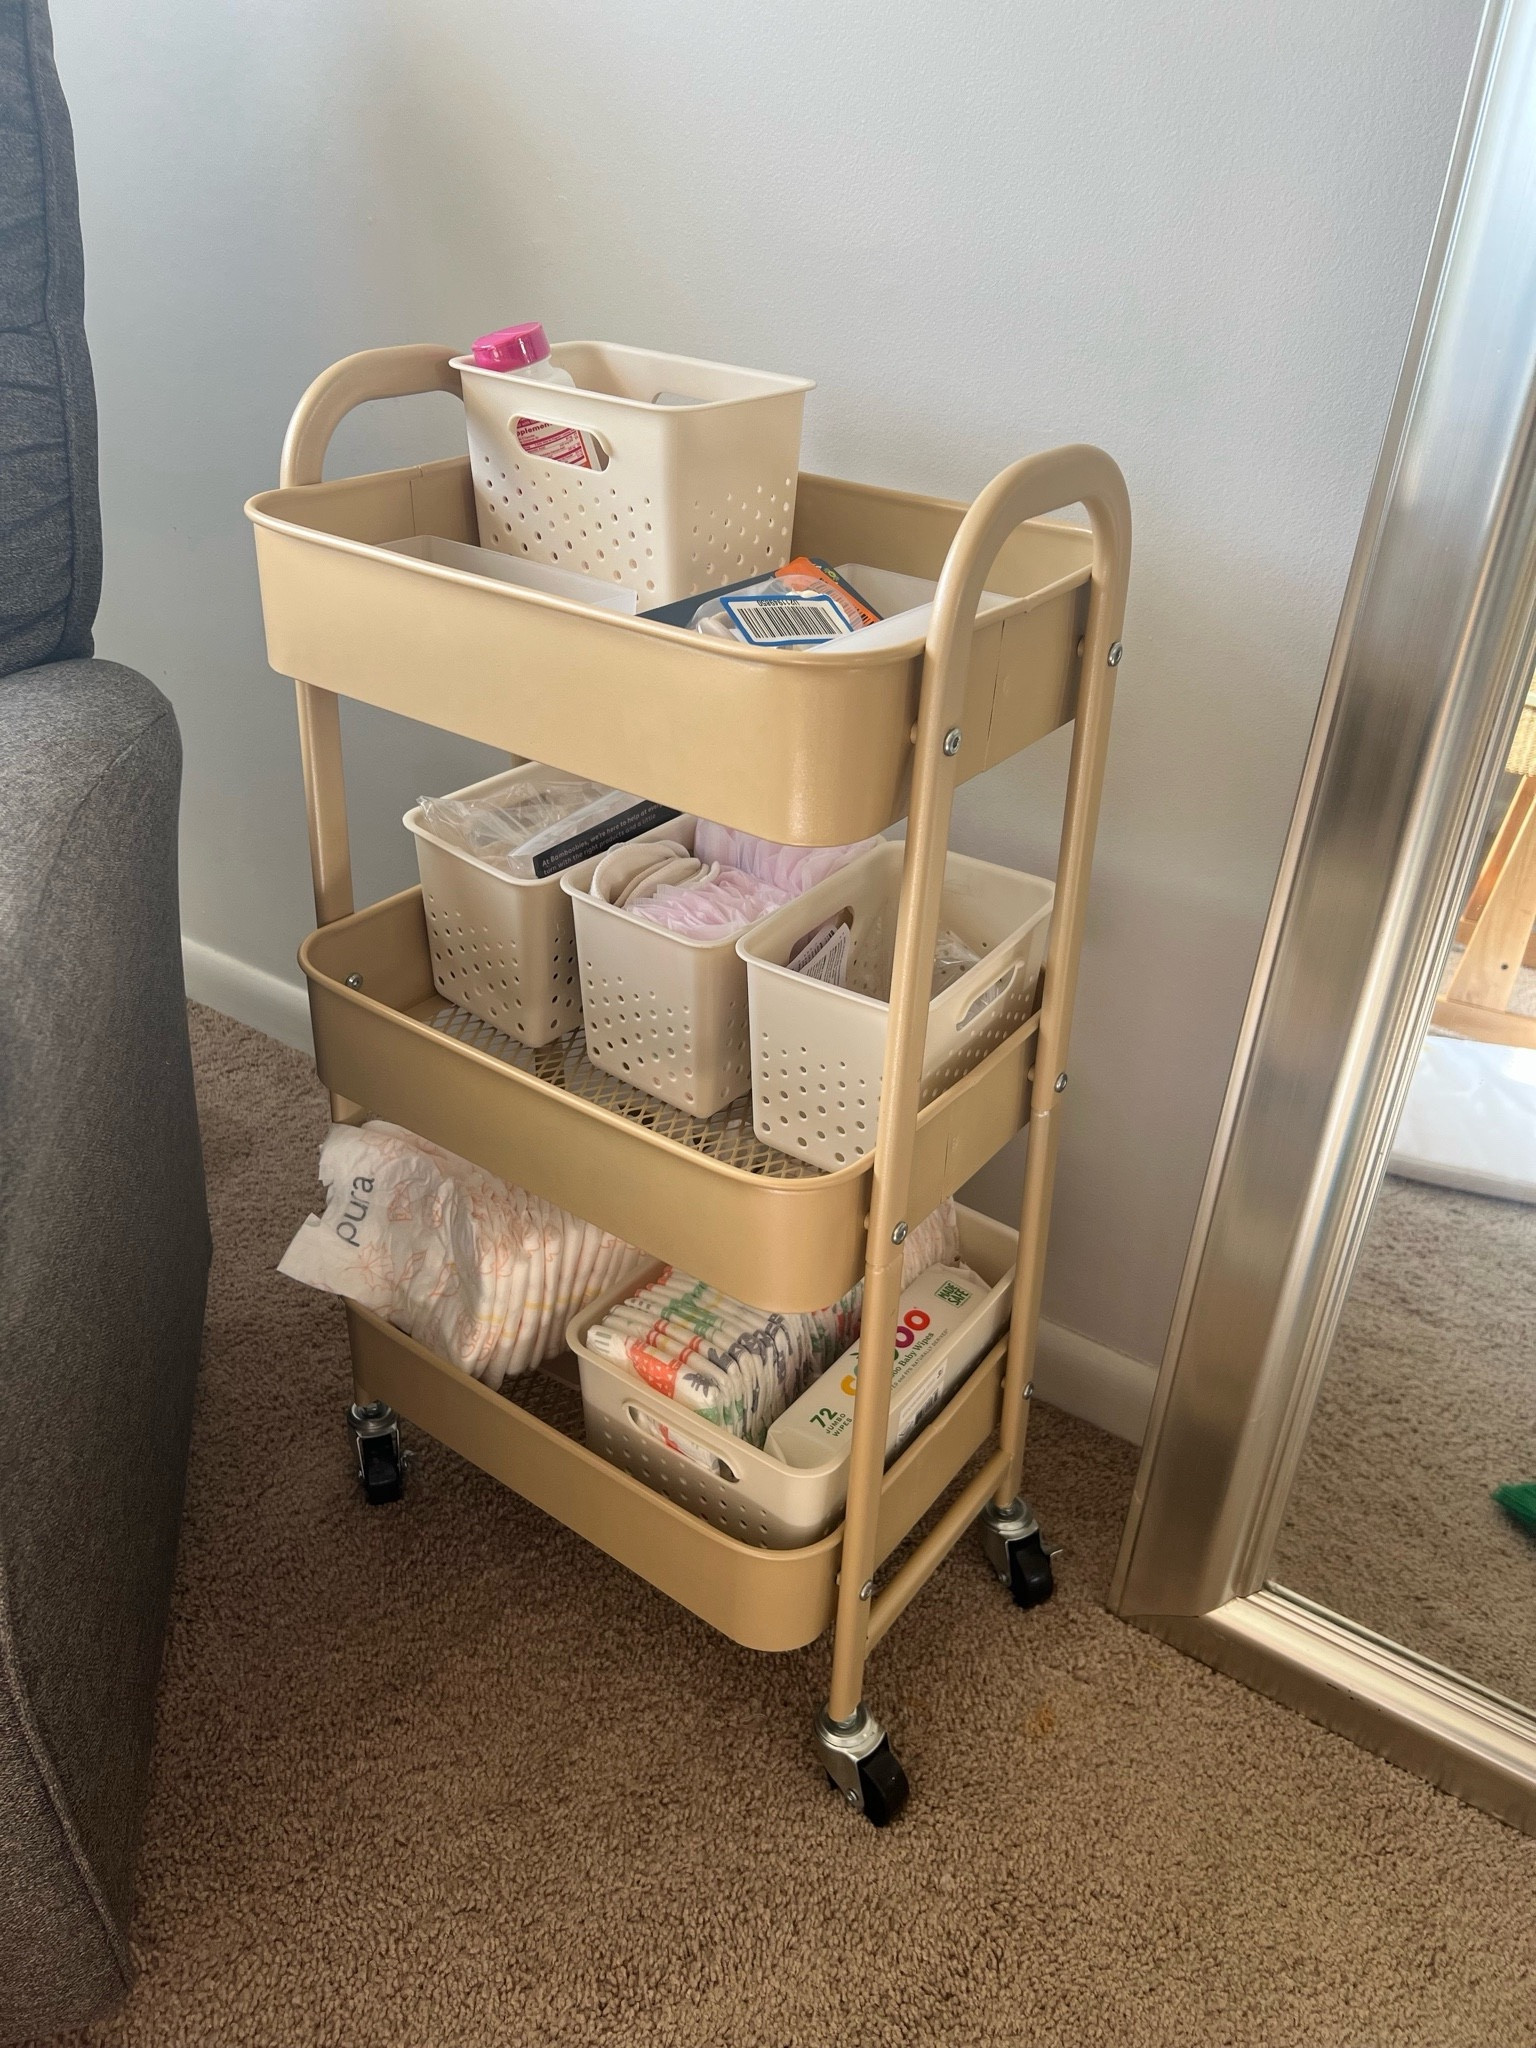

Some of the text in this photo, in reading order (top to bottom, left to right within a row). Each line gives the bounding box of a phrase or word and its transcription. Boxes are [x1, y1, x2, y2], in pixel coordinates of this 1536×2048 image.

[542, 859, 550, 868] At
[606, 824, 620, 834] here
[620, 820, 627, 828] to
[627, 813, 640, 823] help
[640, 809, 647, 817] at
[543, 865, 557, 875] turn
[557, 858, 572, 868] with
[572, 852, 583, 861] the
[583, 844, 598, 855] right
[599, 829, 625, 848] products
[336, 1176, 375, 1248] pura
[937, 1282, 958, 1300] MADE
[947, 1288, 969, 1306] SAFE
[898, 1349, 917, 1367] Baby
[912, 1332, 934, 1351] Wipes
[911, 1346, 932, 1367] NATURALLY
[809, 1407, 838, 1428] 72
[826, 1413, 846, 1434] JUMBO
[832, 1418, 853, 1437] WIPES
